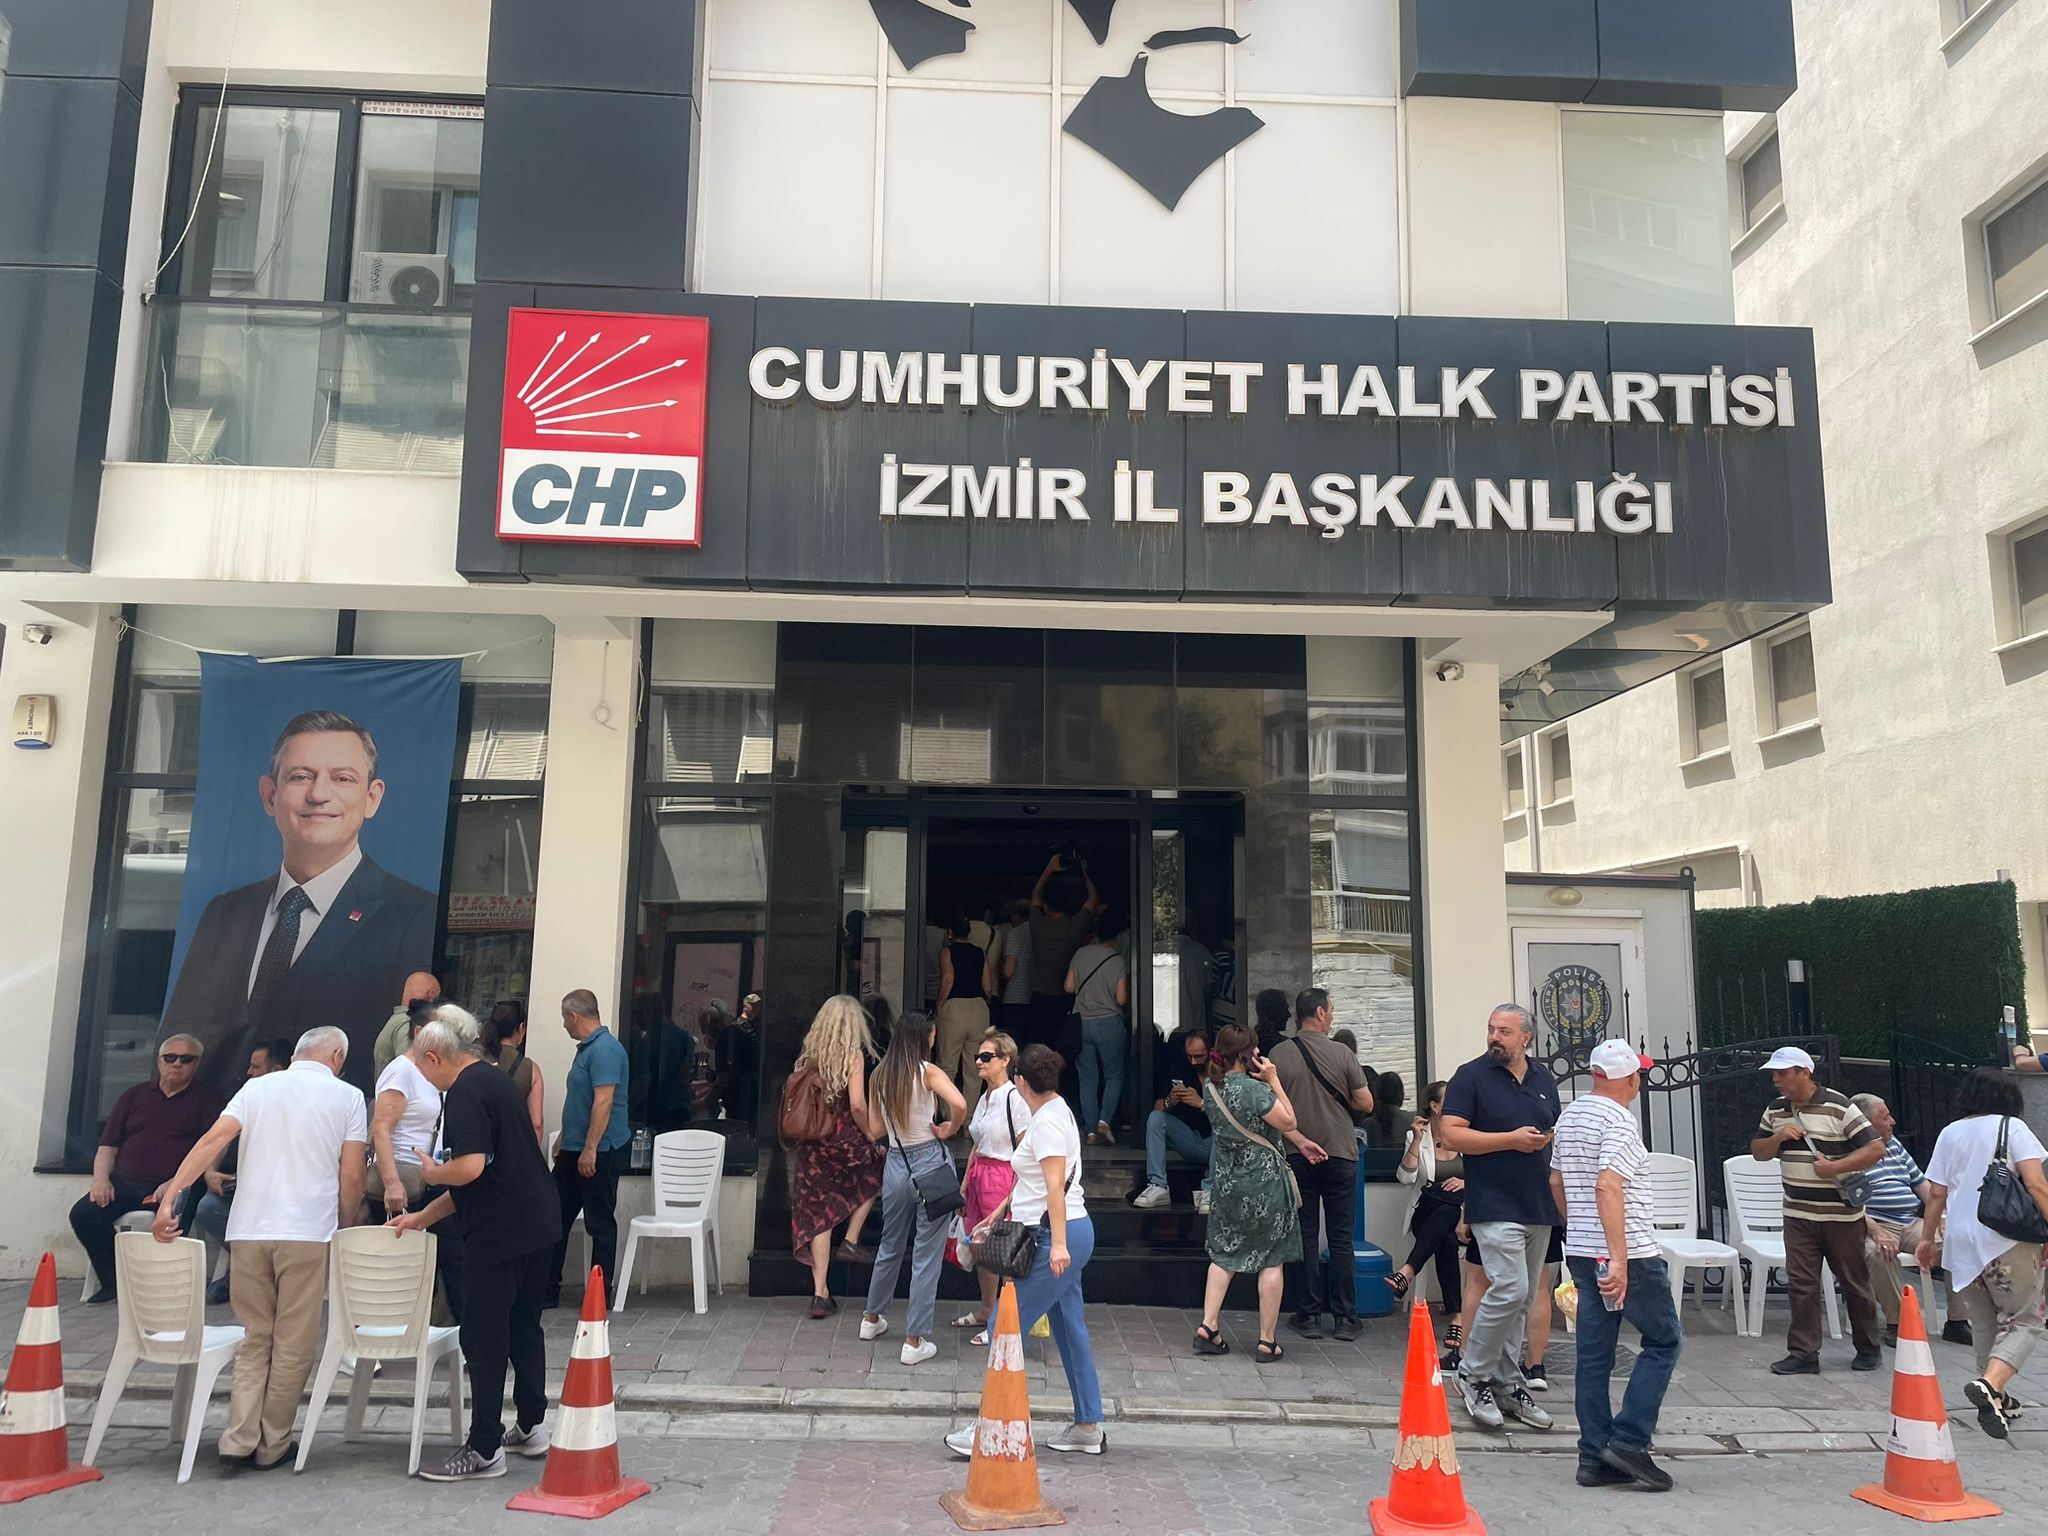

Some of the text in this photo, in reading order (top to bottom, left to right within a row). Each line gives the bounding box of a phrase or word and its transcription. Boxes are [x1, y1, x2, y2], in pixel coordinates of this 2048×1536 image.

[748, 347, 1796, 429] CUMHURİYET HALK PARTİSİ
[511, 463, 686, 527] CHP
[879, 453, 1674, 540] İZMİR İL BAŞKANLIĞI
[1554, 968, 1596, 982] POLİS
